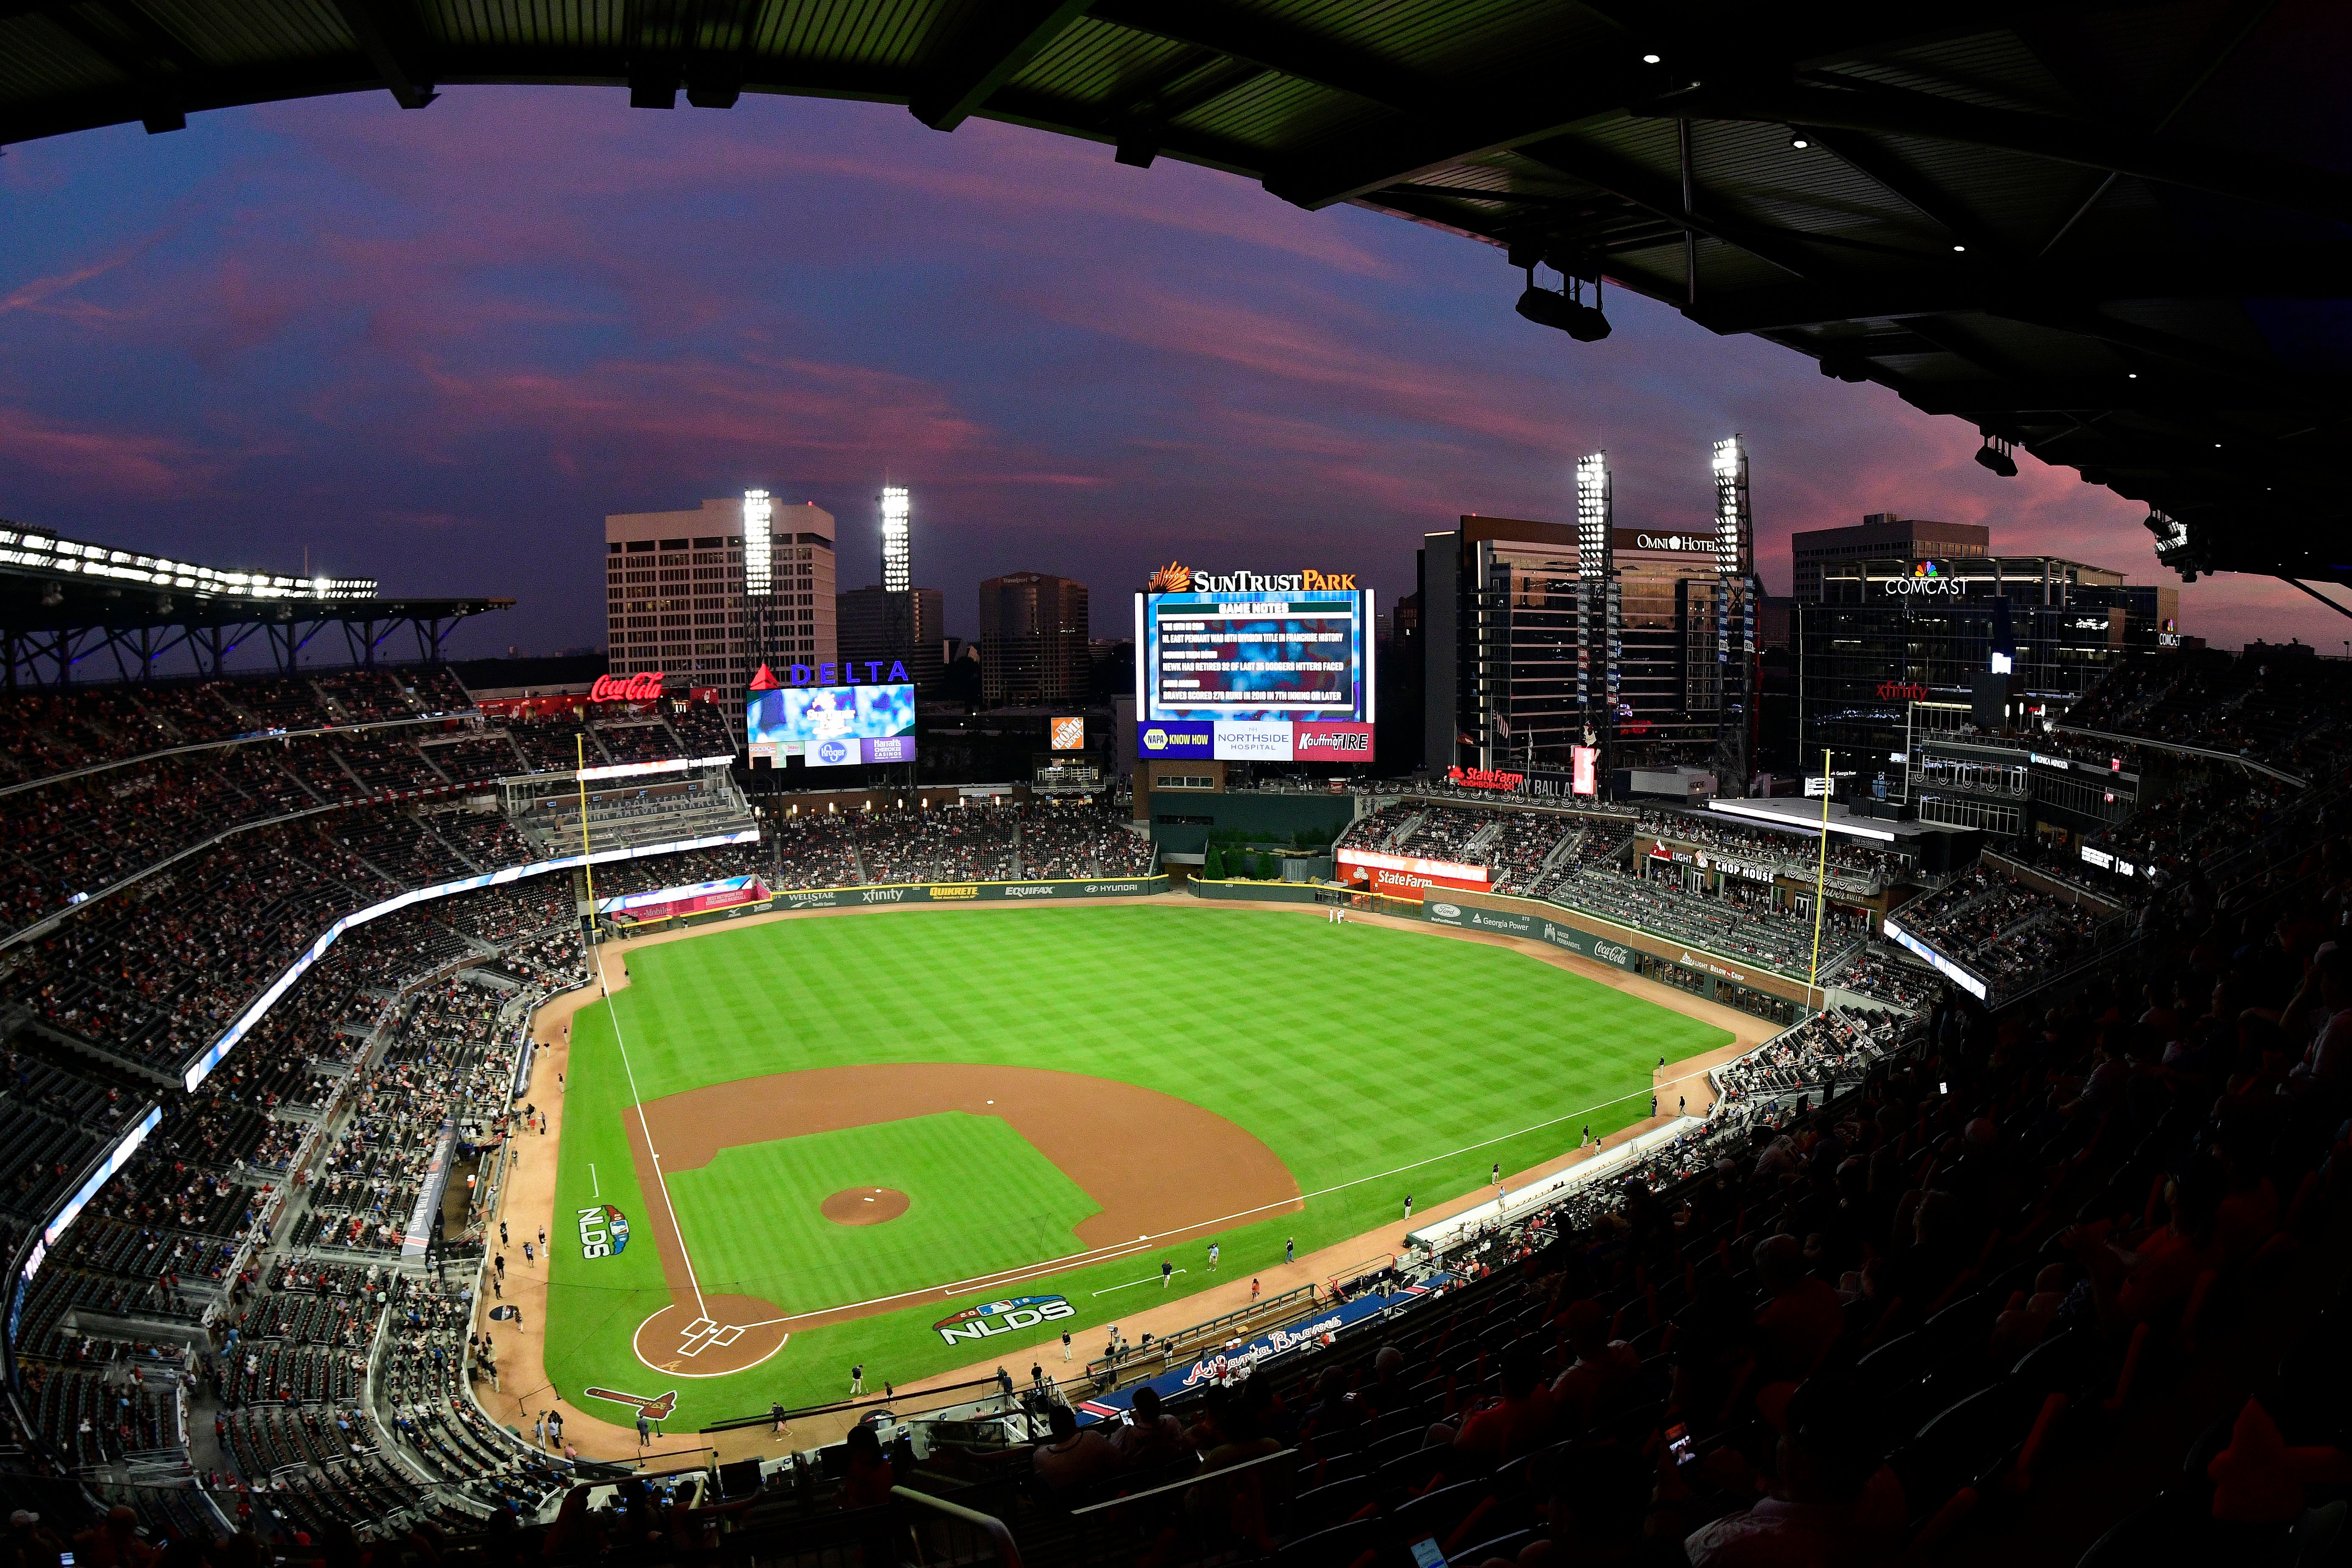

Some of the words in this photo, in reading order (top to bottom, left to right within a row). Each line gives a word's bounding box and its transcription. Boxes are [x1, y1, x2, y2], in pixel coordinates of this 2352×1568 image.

[1637, 534, 1668, 549] OMNI
[1302, 569, 1356, 590] PARK
[1886, 579, 1968, 594] COMCAST
[1252, 603, 1289, 613] NOTES
[1170, 634, 1184, 643] EAST
[1211, 634, 1223, 642] WAS
[1263, 634, 1278, 642] TITLE
[1279, 633, 1285, 642] IN
[1286, 633, 1318, 642] FRANCHISE
[1318, 633, 1343, 642] HISTORY
[791, 661, 908, 685] DELTA
[1162, 662, 1181, 671] NEWK
[1182, 662, 1195, 671] HAS
[1195, 662, 1221, 671] RETIRED
[1230, 662, 1239, 671] OF
[1240, 662, 1255, 671] LAST
[1265, 662, 1295, 671] DODGERS
[1296, 662, 1322, 671] HITTERS
[1323, 662, 1344, 671] FACED
[1163, 691, 1187, 700] BRAVES
[1187, 691, 1212, 700] SCORED
[1225, 691, 1243, 700] RUNS
[1243, 691, 1251, 700] IN
[1267, 691, 1274, 700] IN
[1275, 691, 1287, 700] 7TH
[1288, 691, 1310, 700] INNING
[1311, 691, 1320, 700] OR
[1321, 691, 1341, 700] LATER
[1876, 681, 1929, 703] xfinity
[1052, 718, 1083, 749] HOME
[1055, 721, 1068, 734] THE
[1064, 729, 1083, 749] DEPOT
[1148, 735, 1164, 744] NAPA
[1169, 734, 1190, 745] KNOW
[1192, 735, 1208, 745] HOW
[1298, 733, 1343, 750] Kauffman
[1332, 733, 1369, 751] TIRE
[821, 744, 845, 762] Kroger
[2036, 755, 2050, 765] KONICA
[2050, 759, 2068, 770] MINOLTA
[1535, 780, 1560, 796] BALL
[1672, 852, 1692, 864] LIGHT
[1716, 861, 1740, 875] CHOP
[1743, 868, 1774, 883] HOUSE
[789, 892, 834, 901] WELLSTAR
[862, 888, 903, 903] xfinity
[930, 887, 978, 896] QUIKRETE
[1005, 887, 1054, 897] EQUIFAX
[1846, 894, 1864, 903] BULLET
[1438, 905, 1454, 915] Ford
[1483, 917, 1507, 928] Georgia
[1509, 921, 1529, 931] Power
[1557, 930, 1569, 939] KAISER
[1557, 937, 1580, 950] PERMANENTE
[1695, 961, 1707, 969] LIGHT
[1731, 972, 1744, 981] CHOP
[423, 1173, 438, 1190] HOME
[411, 1209, 427, 1232] BRAVES
[577, 1207, 610, 1259] NLDS
[940, 1301, 1076, 1345] NLDS
[1269, 1315, 1342, 1352] Braves
